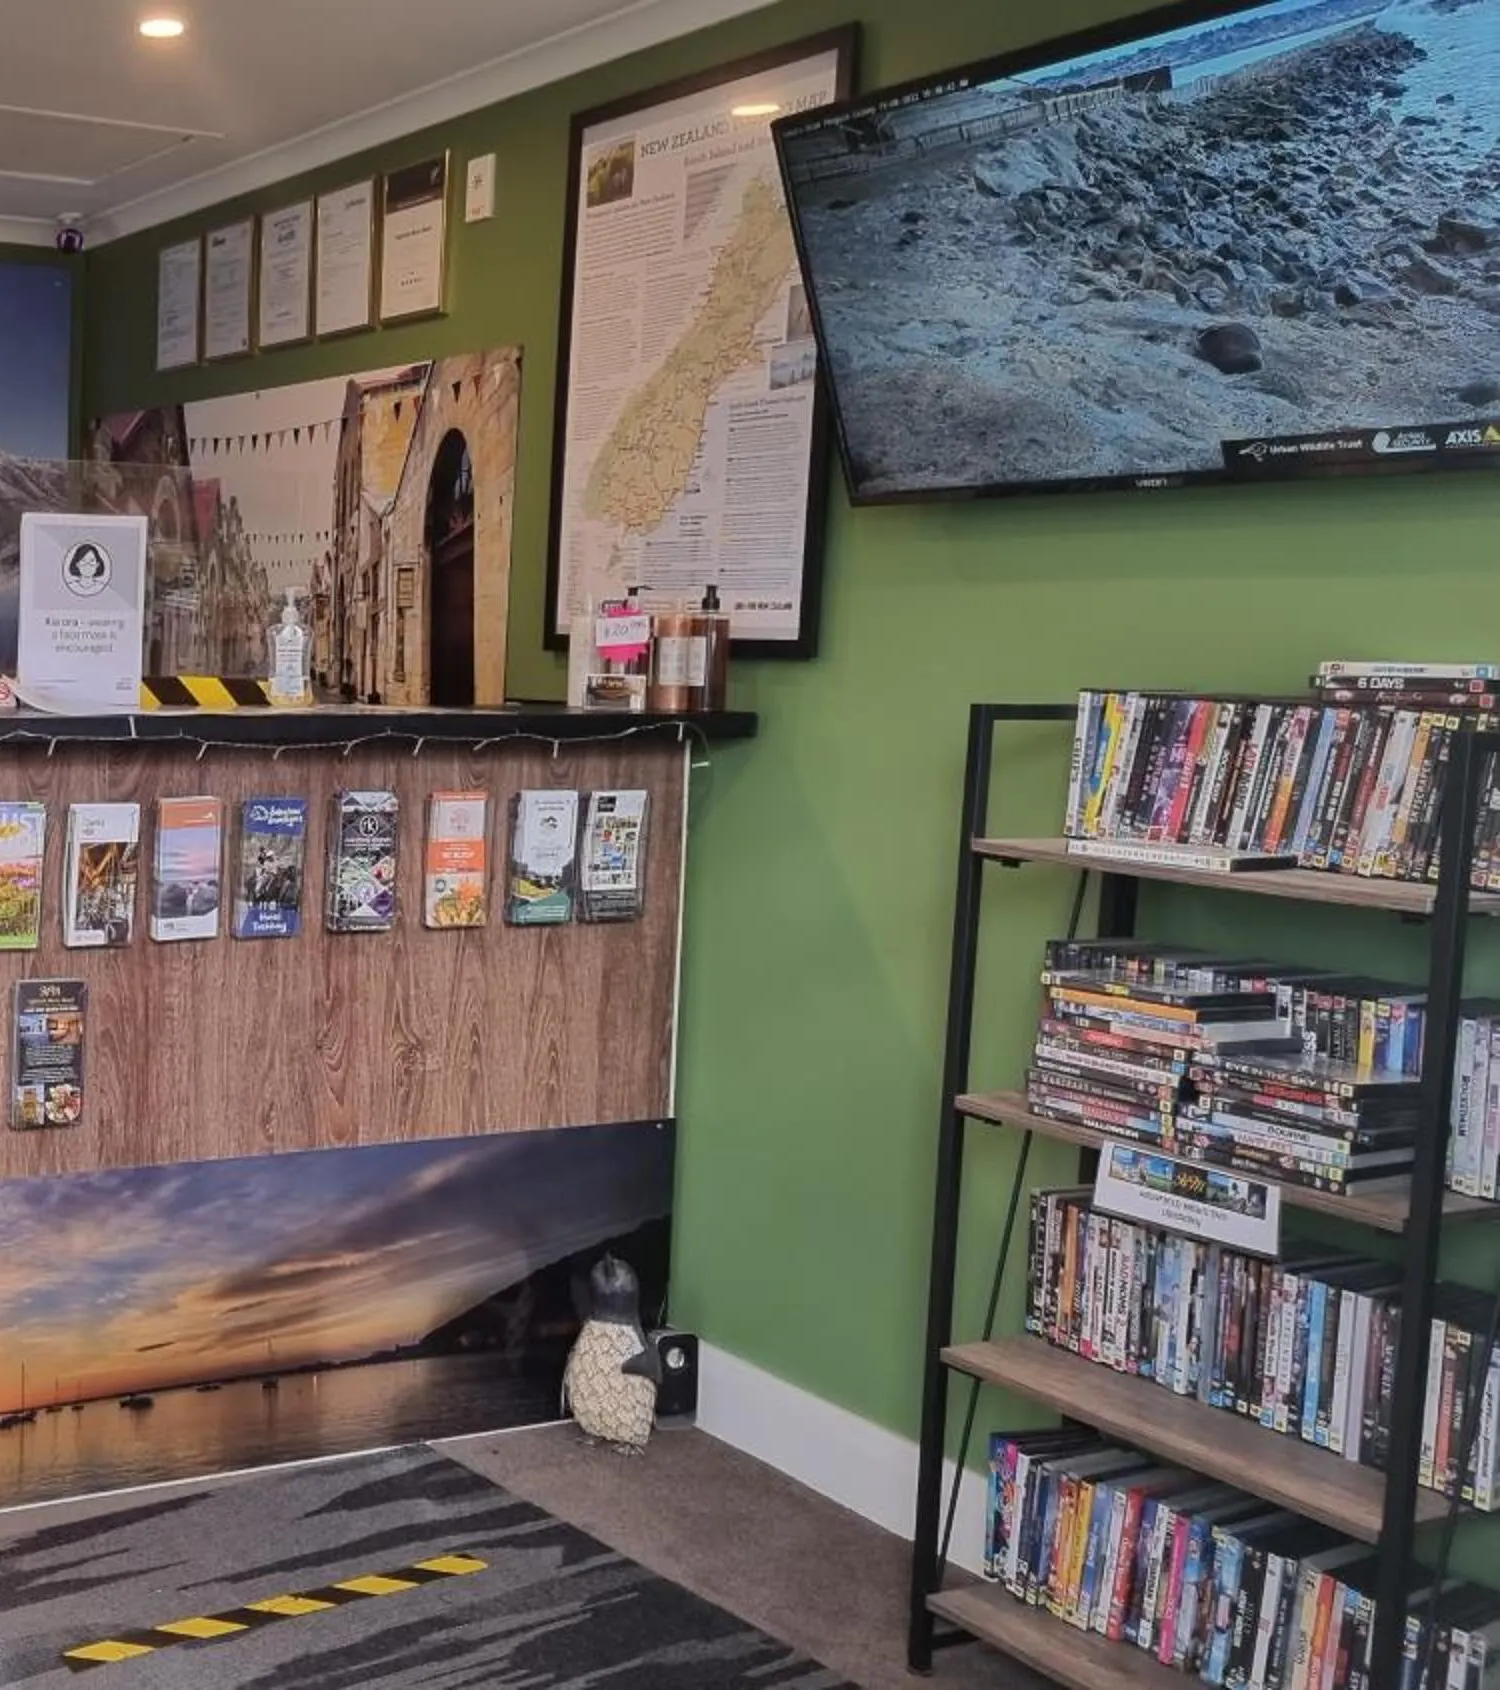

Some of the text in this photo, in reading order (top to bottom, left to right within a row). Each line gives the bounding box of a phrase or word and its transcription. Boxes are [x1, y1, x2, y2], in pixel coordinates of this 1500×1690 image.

[640, 138, 670, 158] NEW
[671, 121, 730, 148] ZEALAND
[1444, 429, 1482, 445] AXIS
[1269, 439, 1364, 454] Urban Wildlife Trust
[1357, 677, 1405, 689] 6 DAYS
[1225, 1060, 1317, 1087] EYE IN THE SKY
